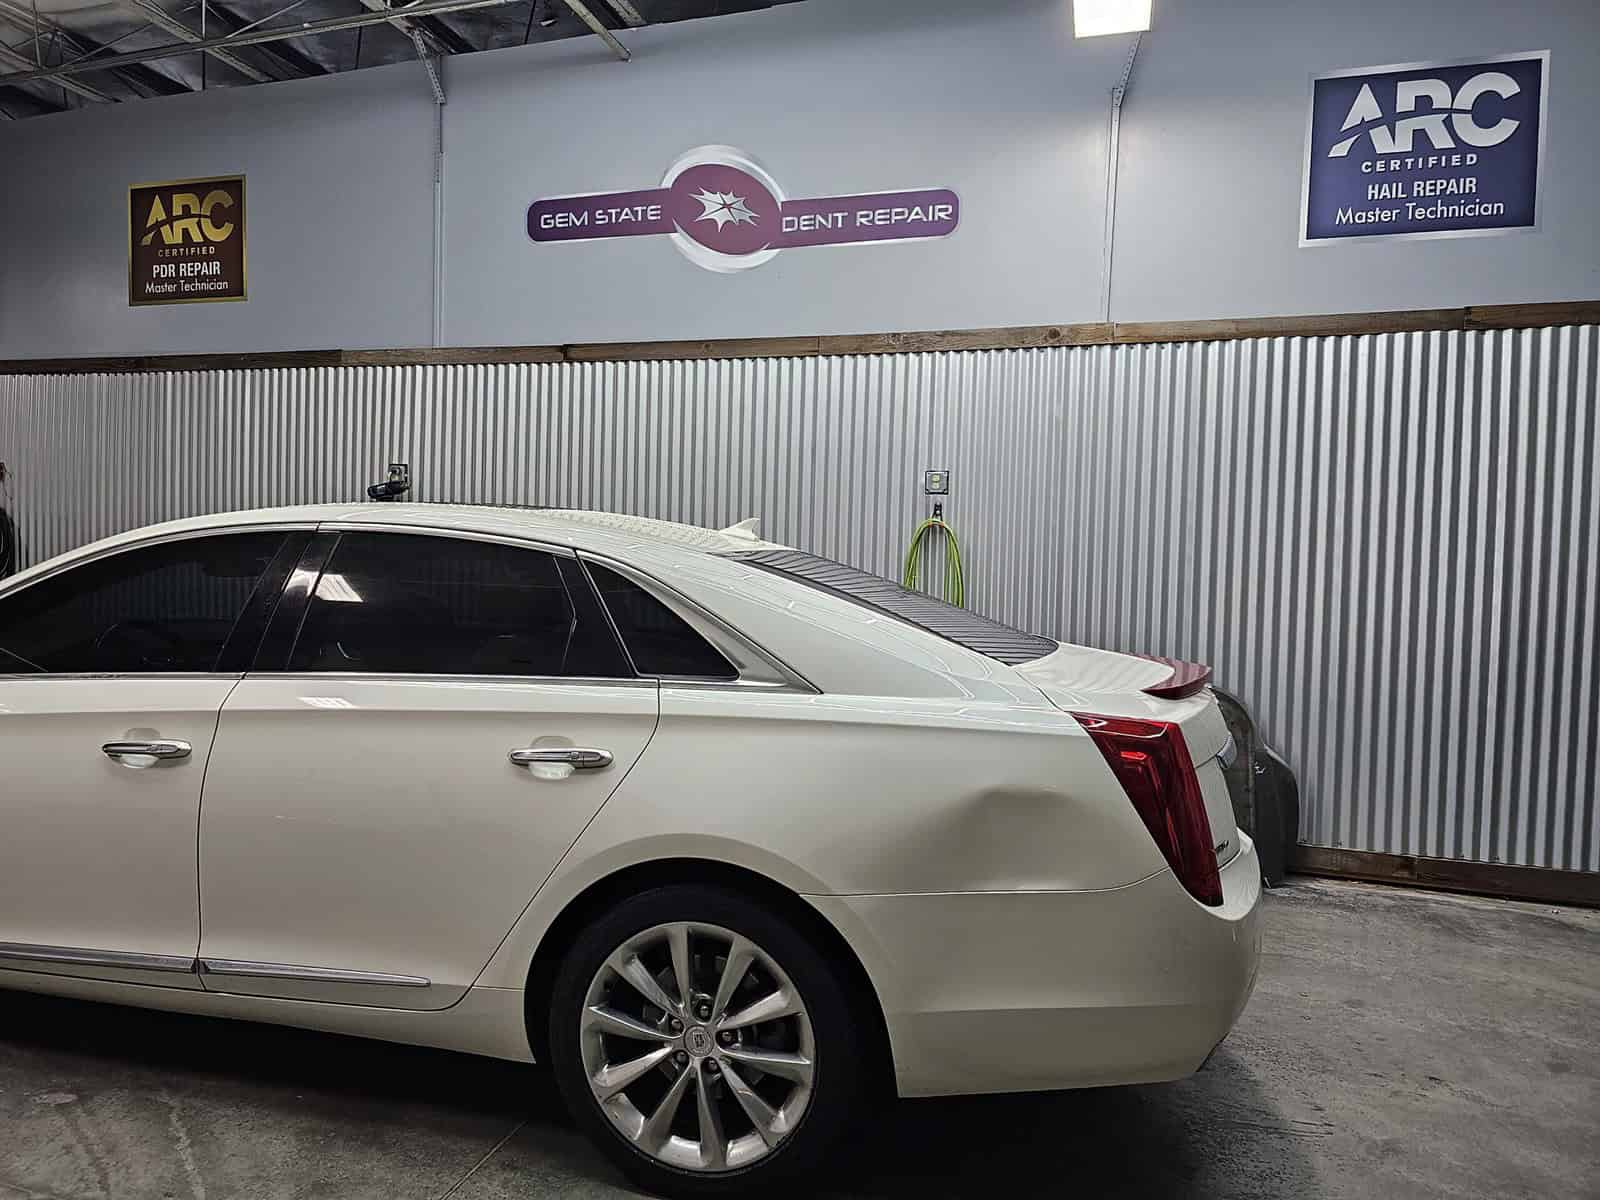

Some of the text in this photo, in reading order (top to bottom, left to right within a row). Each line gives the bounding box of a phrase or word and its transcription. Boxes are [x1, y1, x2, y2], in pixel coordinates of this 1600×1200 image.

[1328, 72, 1521, 158] ARC
[1361, 153, 1478, 173] CERTIFIED
[1367, 177, 1477, 201] HAIL REPAIR
[141, 190, 234, 245] ARC
[540, 204, 954, 233] GEM STATE DENT REPAIR
[1335, 199, 1504, 225] Master Technician
[158, 246, 215, 257] CERTIFIED
[152, 261, 221, 279] PDR REPAIR
[145, 279, 229, 294] Master Technician
